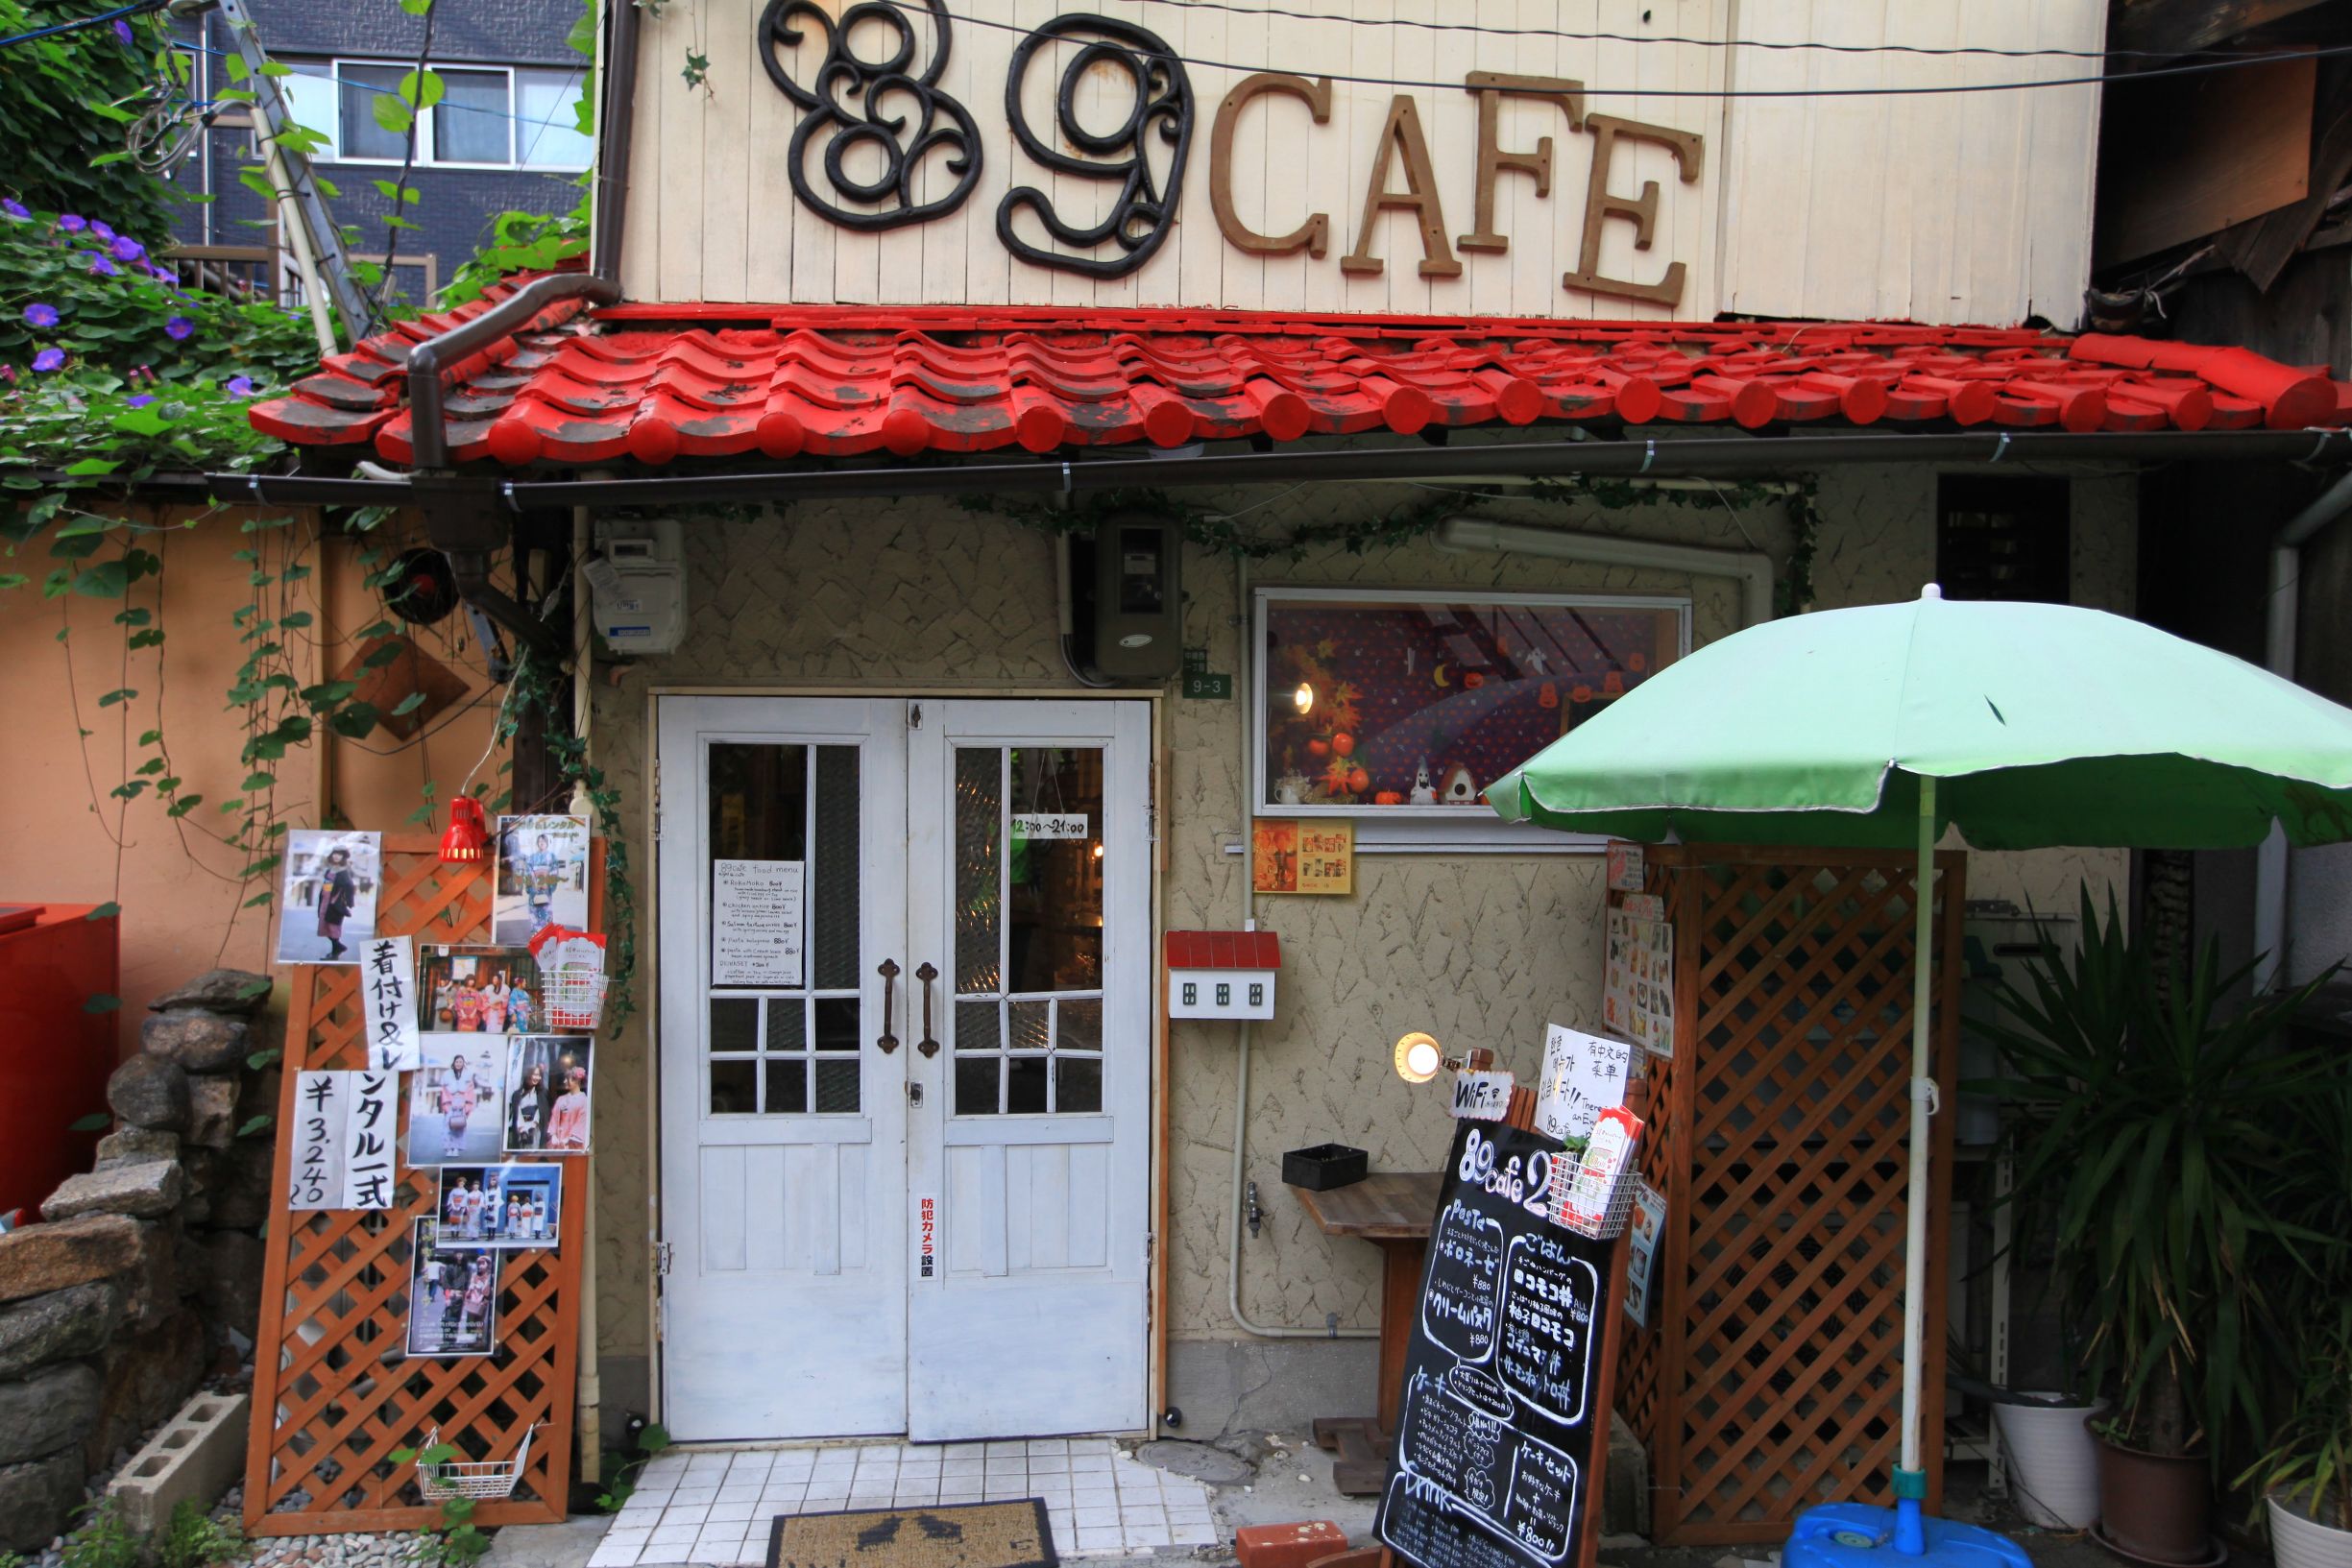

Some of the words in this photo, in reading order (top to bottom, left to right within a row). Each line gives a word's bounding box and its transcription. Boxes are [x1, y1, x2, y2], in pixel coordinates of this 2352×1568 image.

[1209, 70, 1705, 308] CAFE
[1193, 680, 1221, 693] 9-3
[753, 865, 772, 875] food
[1587, 1041, 1629, 1064] 有中文的
[1456, 1079, 1490, 1111] WiFi
[1523, 1149, 1553, 1218] 2
[921, 1197, 934, 1277] 防犯カメラ設置
[1525, 1233, 1571, 1266] ごはん
[1444, 1239, 1500, 1276] ボロネーゼ
[1472, 1274, 1491, 1291] ¥880
[1514, 1268, 1573, 1308] ロコモコ丼
[1433, 1292, 1493, 1332] クリームパスタ
[1573, 1298, 1588, 1313] ALL
[1469, 1332, 1489, 1347] ¥880
[1415, 1363, 1446, 1396] ケーキ
[1520, 1439, 1572, 1484] ケーキセット
